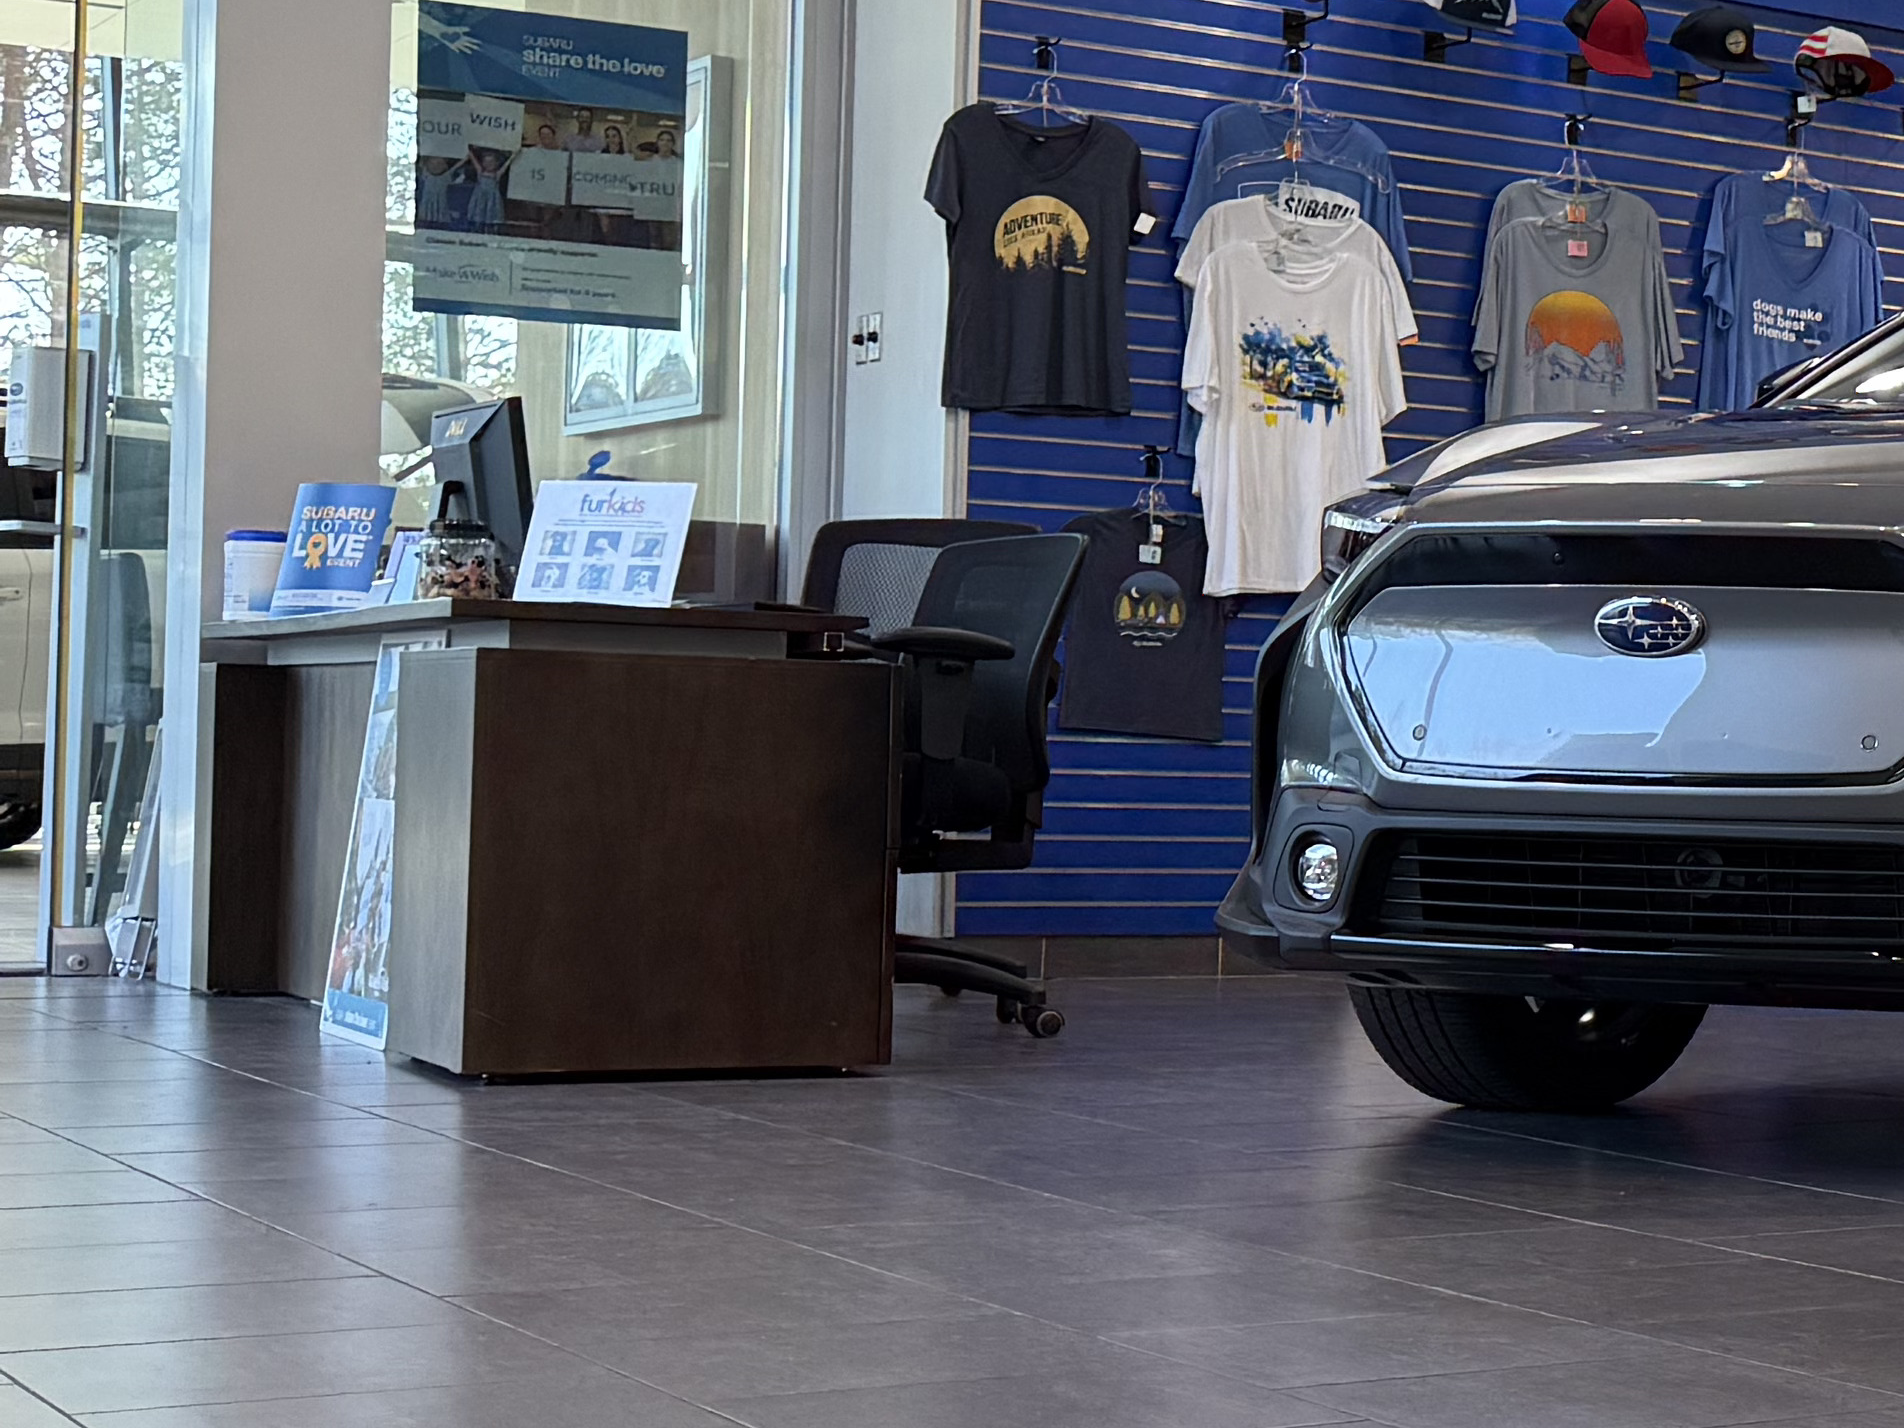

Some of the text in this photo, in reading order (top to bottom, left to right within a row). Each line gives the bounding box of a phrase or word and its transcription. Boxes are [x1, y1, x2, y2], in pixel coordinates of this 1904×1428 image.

[522, 34, 573, 49] SUBARU
[522, 47, 665, 78] share the love
[469, 112, 517, 131] WISH
[532, 168, 546, 181] IS
[1003, 211, 1064, 238] ADVENTURE
[1753, 299, 1823, 322] dogs make
[1753, 311, 1805, 331] the best
[1753, 323, 1796, 342] friends
[580, 488, 645, 514] furkids
[301, 505, 376, 521] SUBARU
[300, 520, 372, 534] A LOT TO
[292, 532, 369, 565] LOVE
